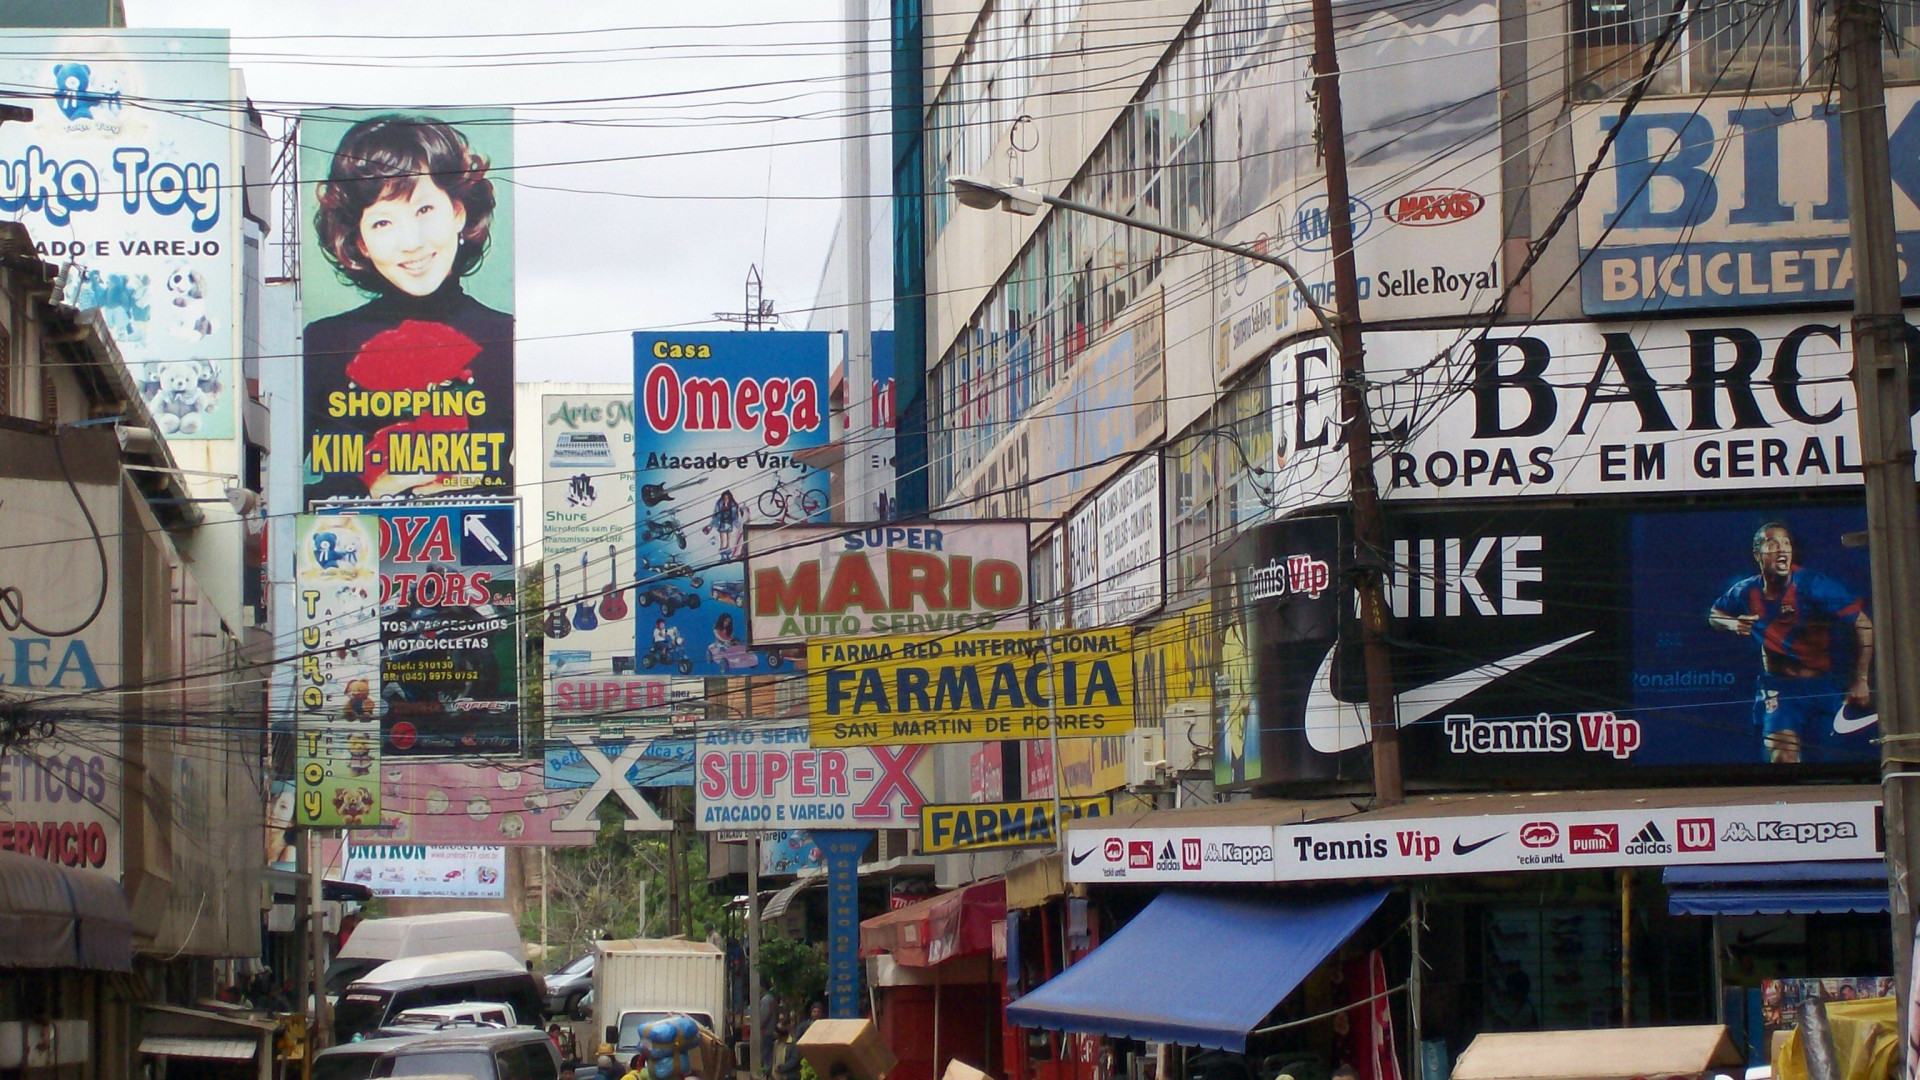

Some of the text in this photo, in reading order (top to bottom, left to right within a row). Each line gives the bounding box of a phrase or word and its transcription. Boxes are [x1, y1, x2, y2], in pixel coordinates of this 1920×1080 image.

[112, 147, 221, 233] Toy
[1397, 192, 1475, 222] MAXXIS
[95, 240, 110, 256] E
[119, 240, 220, 256] VAREJO
[1602, 243, 1907, 301] BICICLETA
[653, 341, 712, 359] Casa
[328, 391, 487, 417] SHOPPING
[644, 363, 821, 447] Omega
[312, 432, 506, 473] KIM MARKET
[645, 451, 816, 474] Atacado e Varej
[1391, 436, 1863, 489] ROPAS EM GERAL
[443, 478, 457, 486] DE
[460, 477, 482, 486] ELA
[546, 511, 587, 522] Shure
[843, 527, 944, 551] SUPER
[754, 548, 1022, 618] MARIO
[1287, 554, 1329, 599] Vip
[778, 615, 861, 637] AUTO
[387, 637, 489, 650] MOTOCICLETAS
[822, 635, 1123, 663] FARMA RED INTERNACIONAL
[0, 637, 104, 690] FA
[555, 680, 668, 712] SUPER
[825, 660, 1123, 716] FARMACIA
[705, 728, 754, 746] AUTO
[834, 714, 1106, 740] SAN MARTIN DE PORRES
[1445, 711, 1641, 759] Tennis Vip
[701, 745, 926, 819] SUPER-X
[705, 803, 845, 823] ATACADO E VAREJO
[1573, 838, 1607, 851] PUMA
[1757, 820, 1857, 844] Kappa
[1221, 842, 1274, 866] Kappa
[1294, 831, 1440, 862] Tennis Vip
[1625, 840, 1672, 855] adidas
[1156, 857, 1181, 871] adidas
